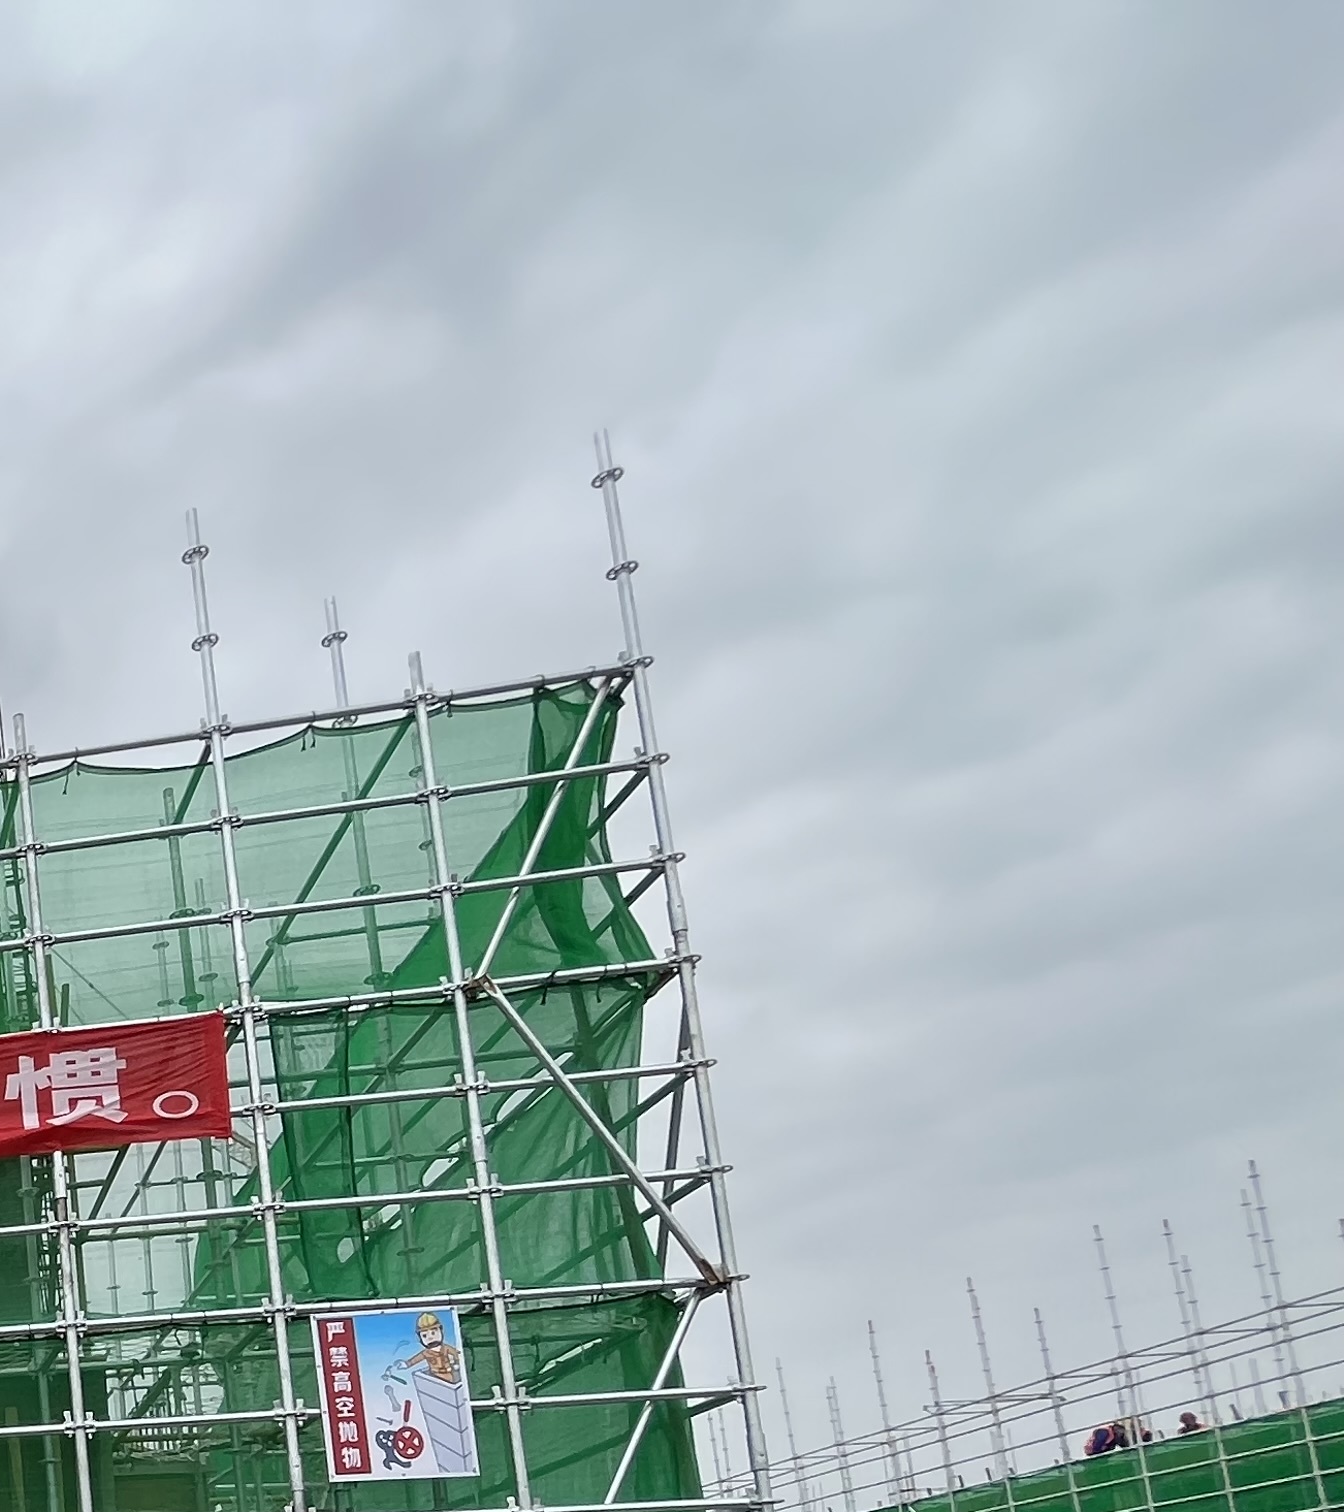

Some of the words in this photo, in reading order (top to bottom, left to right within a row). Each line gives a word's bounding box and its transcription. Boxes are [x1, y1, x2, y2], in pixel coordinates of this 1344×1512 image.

[325, 1321, 363, 1470] 严禁高空抛物
